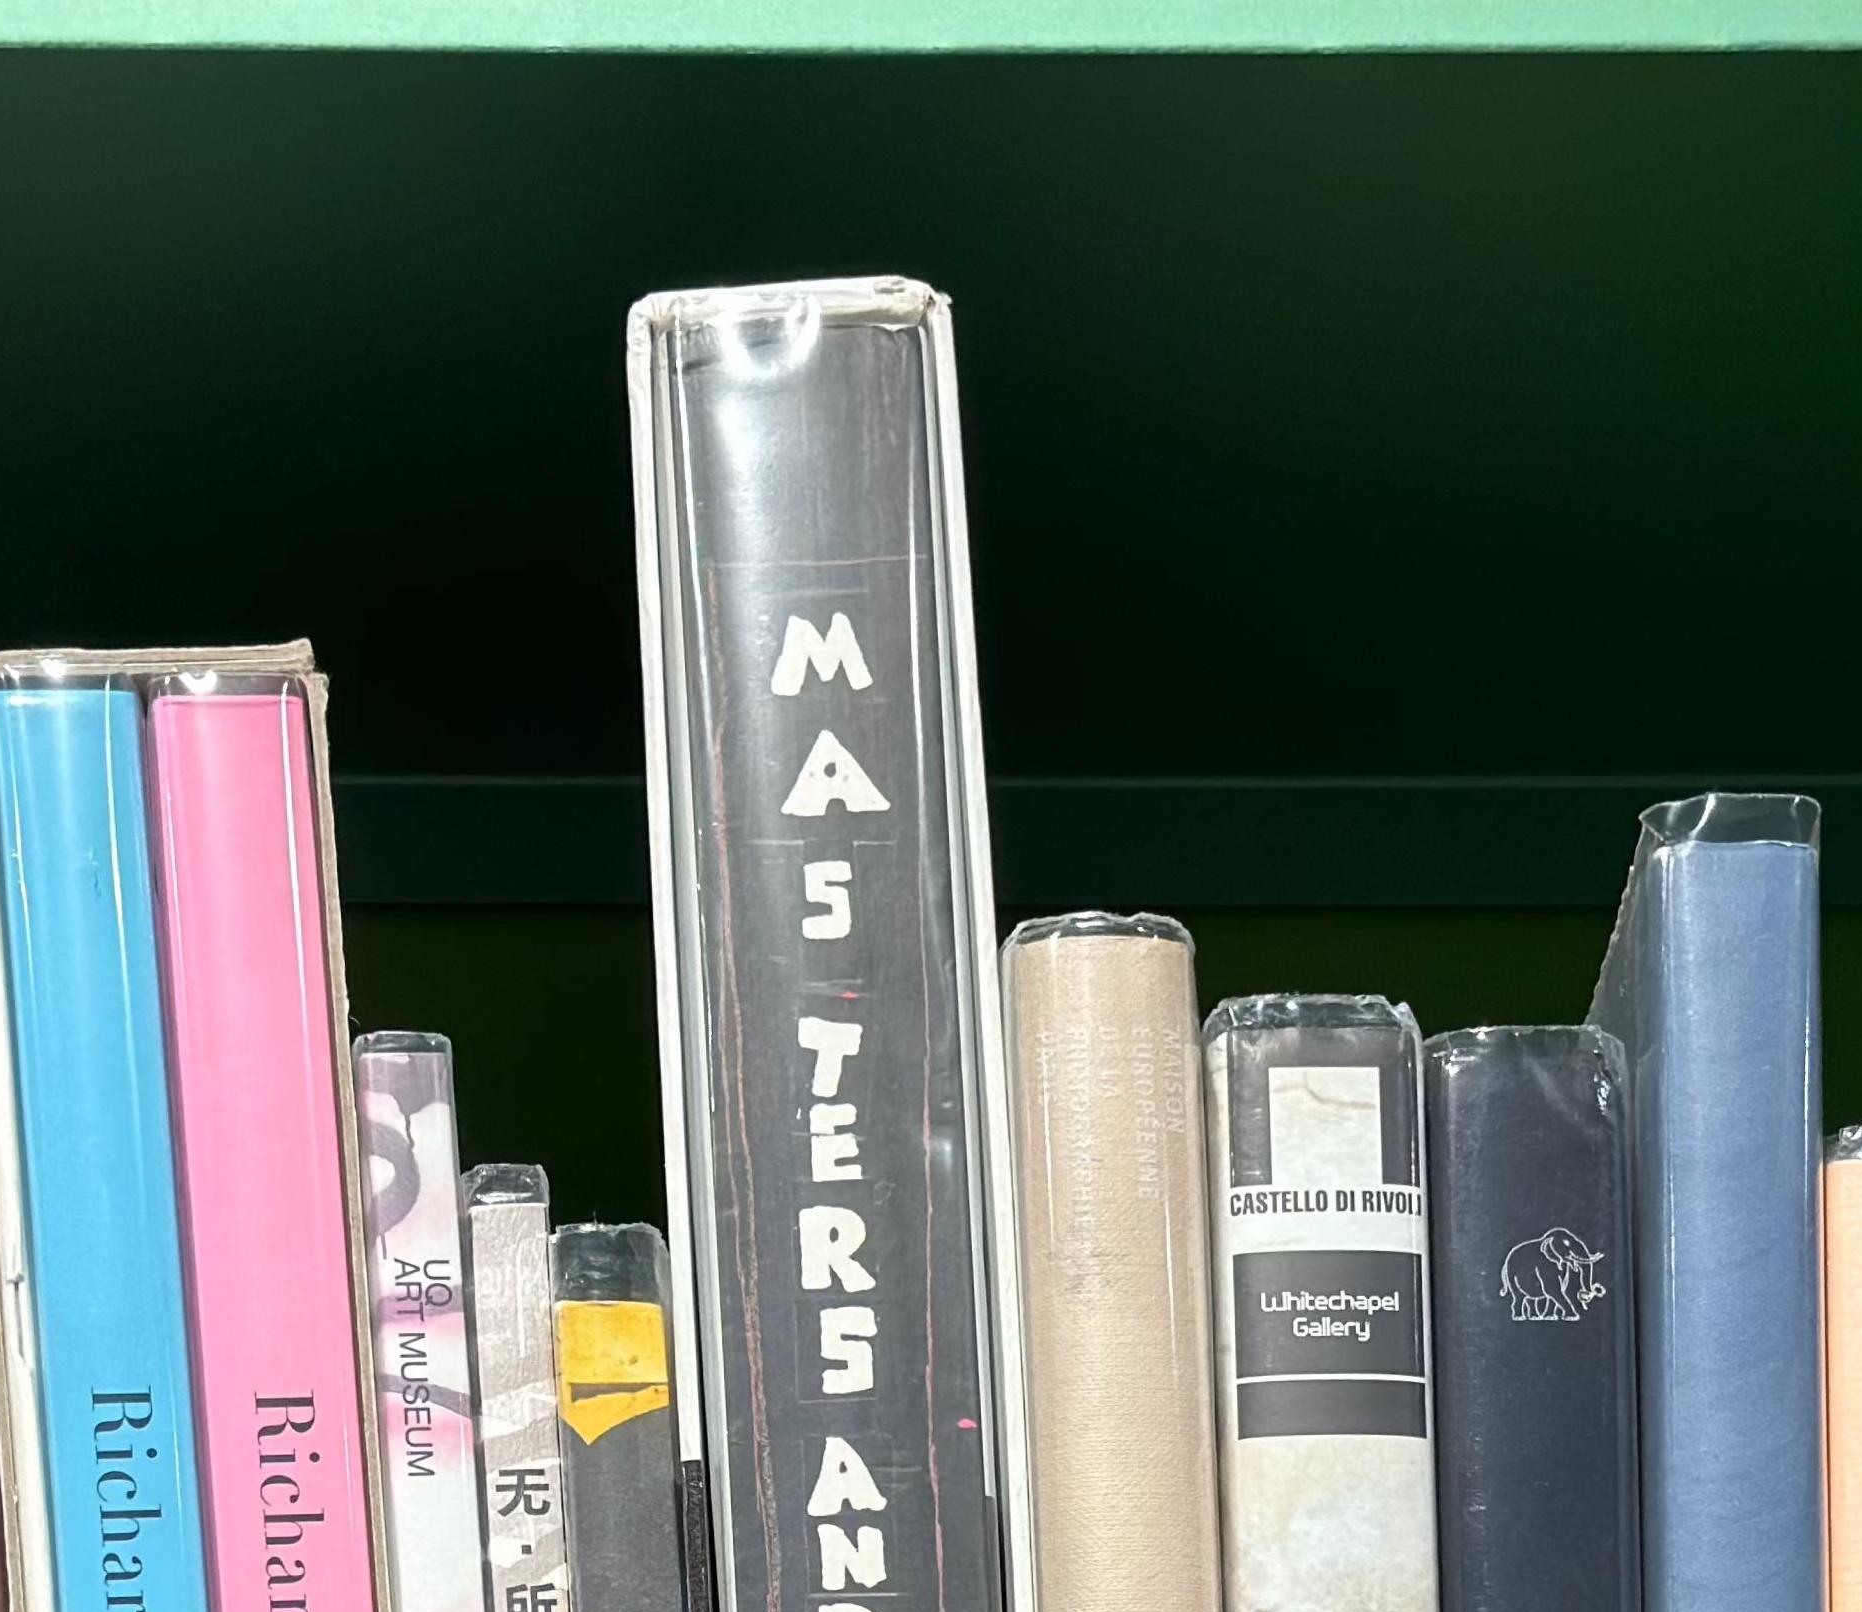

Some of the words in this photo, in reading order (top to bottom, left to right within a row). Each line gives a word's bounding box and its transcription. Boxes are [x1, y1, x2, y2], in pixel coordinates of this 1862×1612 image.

[1161, 1027, 1187, 1135] MAISON
[1130, 1024, 1162, 1200] EUROPÉENNE
[1230, 1190, 1329, 1217] CASTELLO
[1335, 1190, 1356, 1213] DI
[394, 1258, 427, 1323] ART
[422, 1259, 453, 1307] UQ
[1260, 1289, 1400, 1316] Whitechapel
[1292, 1316, 1371, 1342] Gallery
[397, 1332, 436, 1478] MUSEUM
